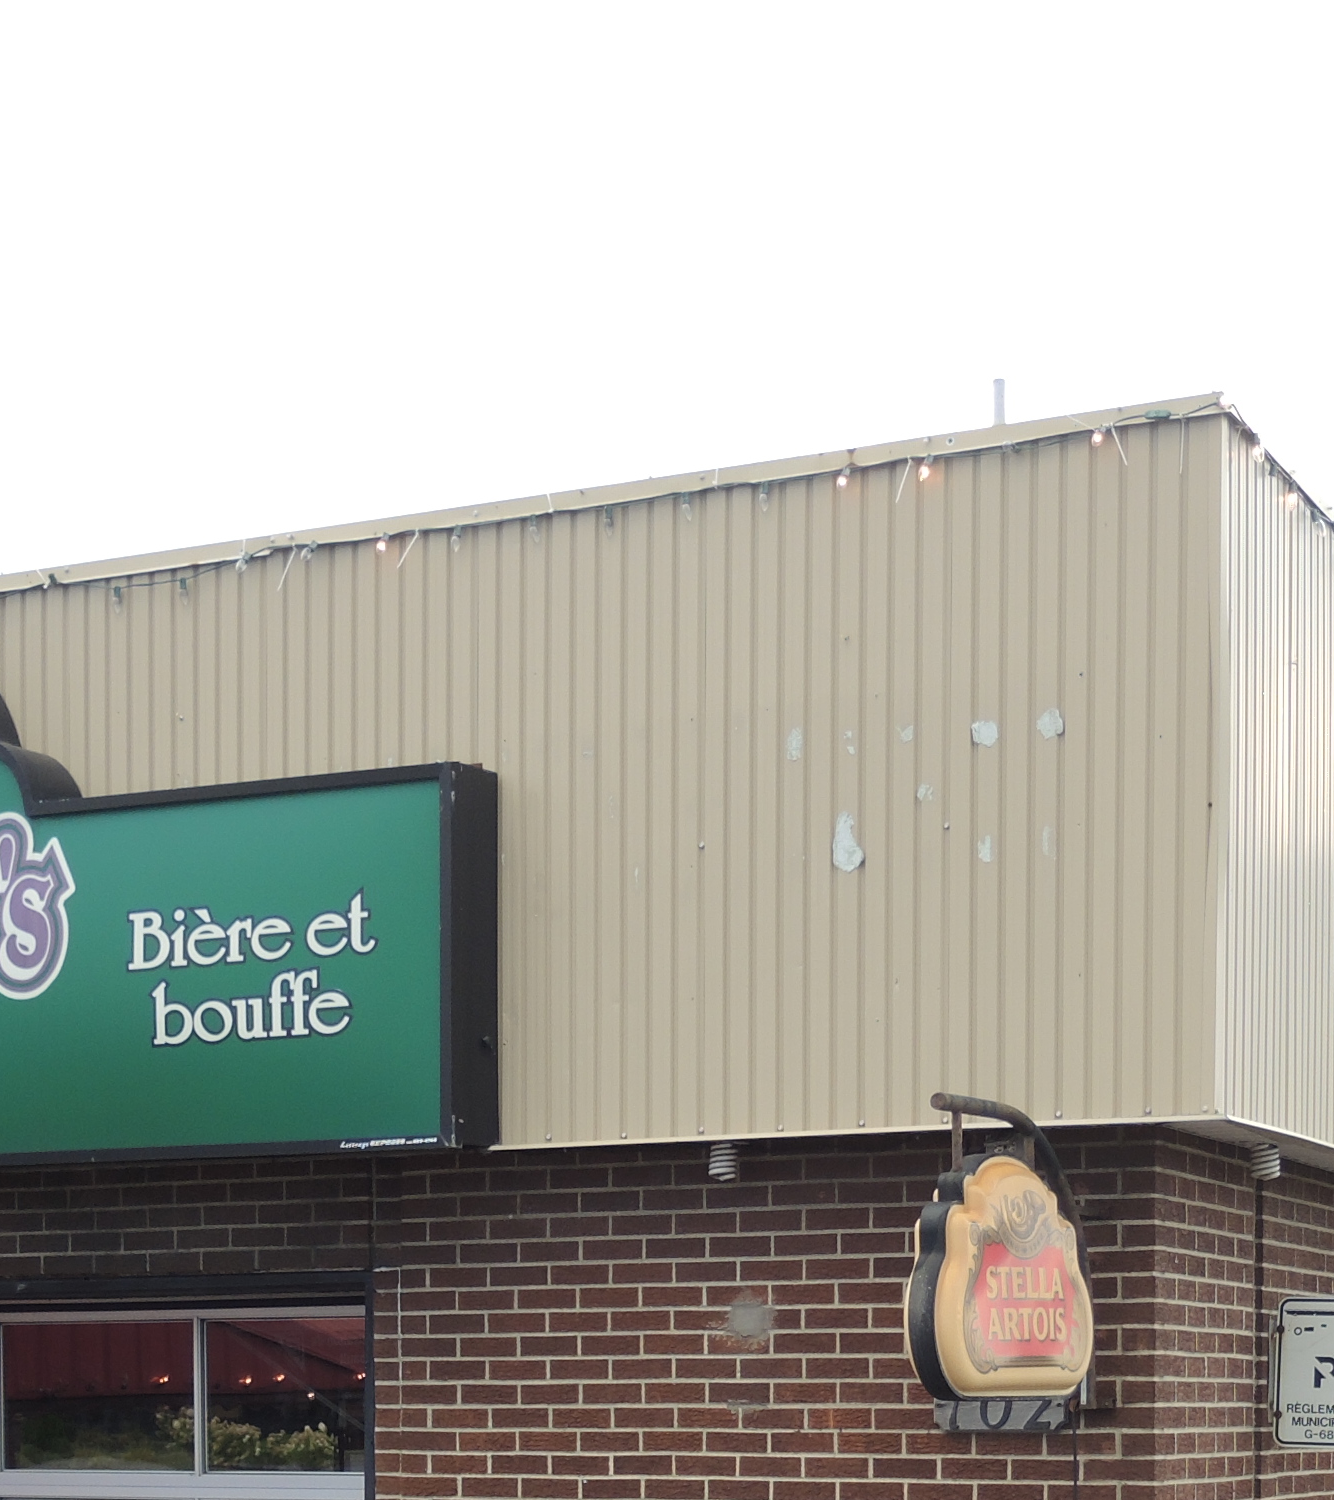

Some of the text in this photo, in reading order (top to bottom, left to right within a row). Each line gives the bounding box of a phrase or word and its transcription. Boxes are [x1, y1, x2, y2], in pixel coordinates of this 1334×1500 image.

[127, 889, 378, 971] Bière et
[150, 967, 352, 1047] bouffe
[985, 1265, 1065, 1301] STELLA
[986, 1306, 1067, 1342] ARTOIS
